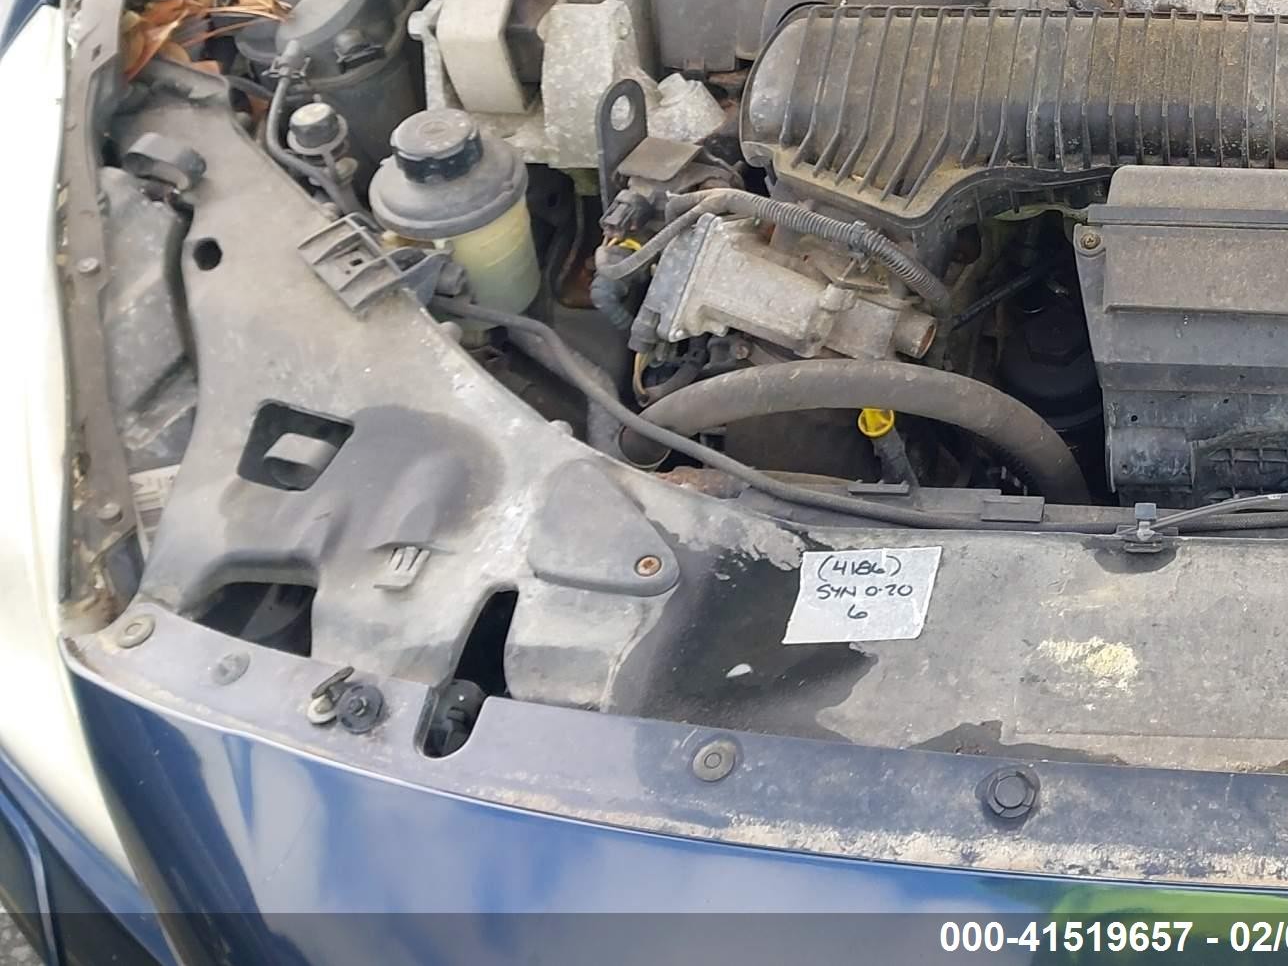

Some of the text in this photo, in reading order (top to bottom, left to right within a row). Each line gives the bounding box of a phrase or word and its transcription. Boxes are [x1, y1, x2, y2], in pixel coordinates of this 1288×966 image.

[817, 555, 902, 581] (4186)
[816, 583, 857, 600] SYN
[846, 603, 869, 620] 6
